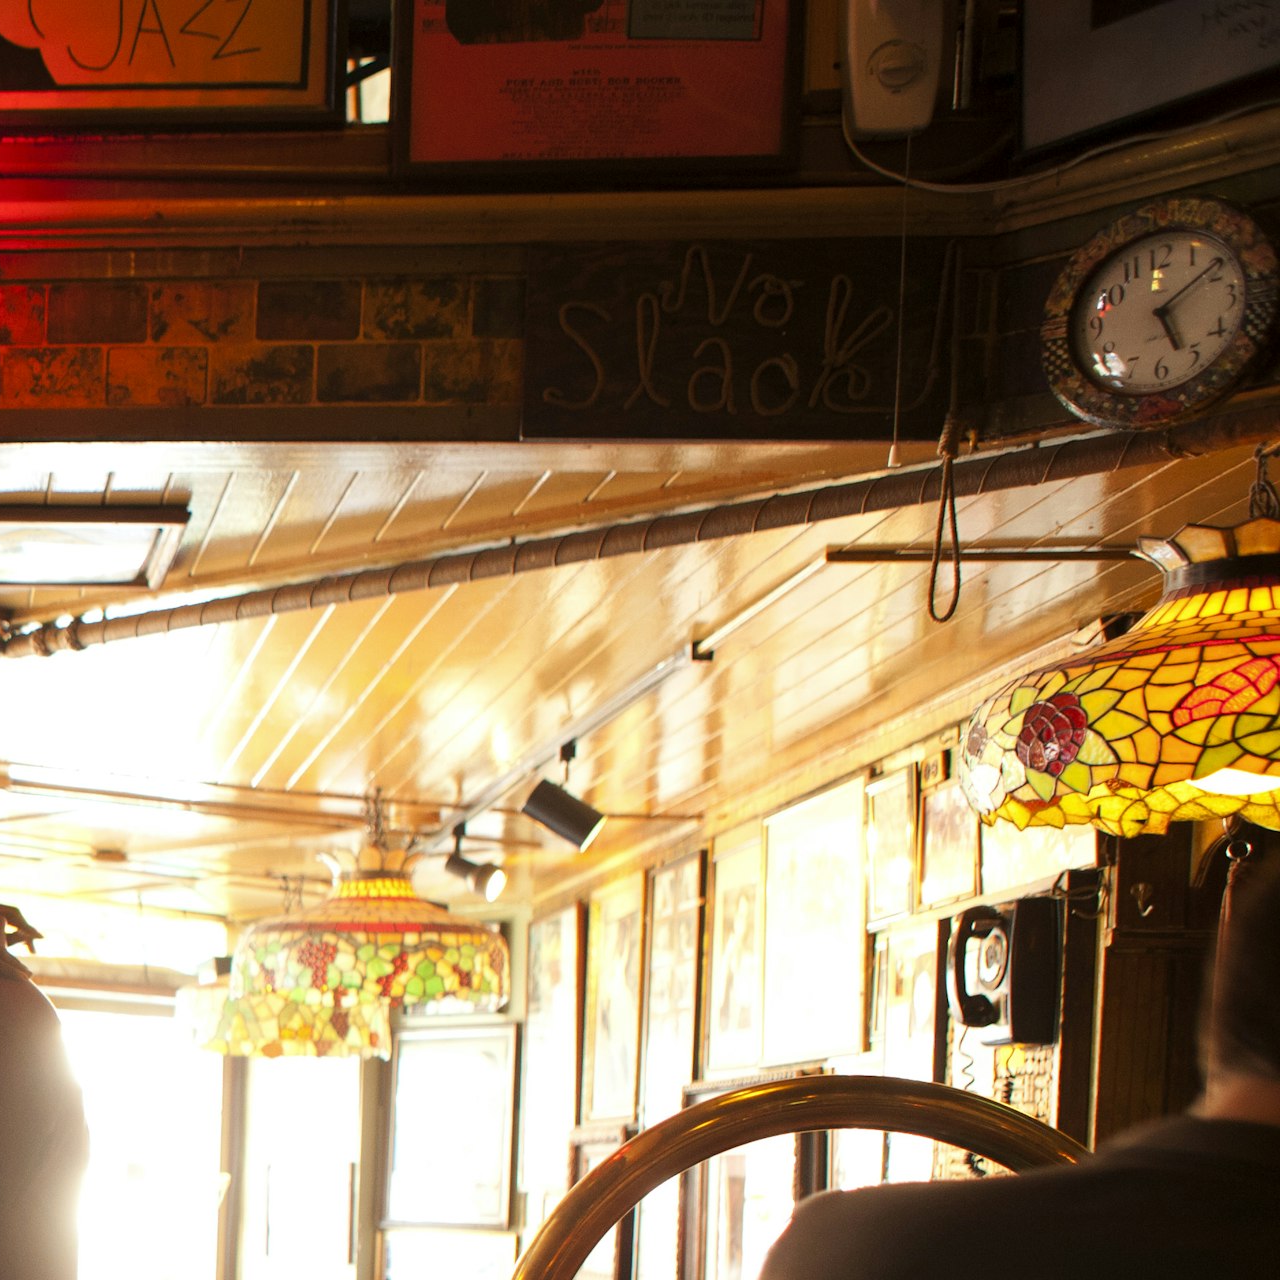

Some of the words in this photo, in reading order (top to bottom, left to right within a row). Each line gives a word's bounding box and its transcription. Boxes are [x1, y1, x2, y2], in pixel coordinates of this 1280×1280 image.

[1150, 243, 1174, 272] 12
[1189, 244, 1198, 267] 1
[1123, 256, 1141, 284] 11
[1225, 284, 1237, 311] 3
[1089, 316, 1104, 341] 9
[1206, 317, 1227, 339] 4
[1126, 355, 1141, 380] 7
[1189, 342, 1202, 369] 5
[1153, 356, 1170, 381] 6
